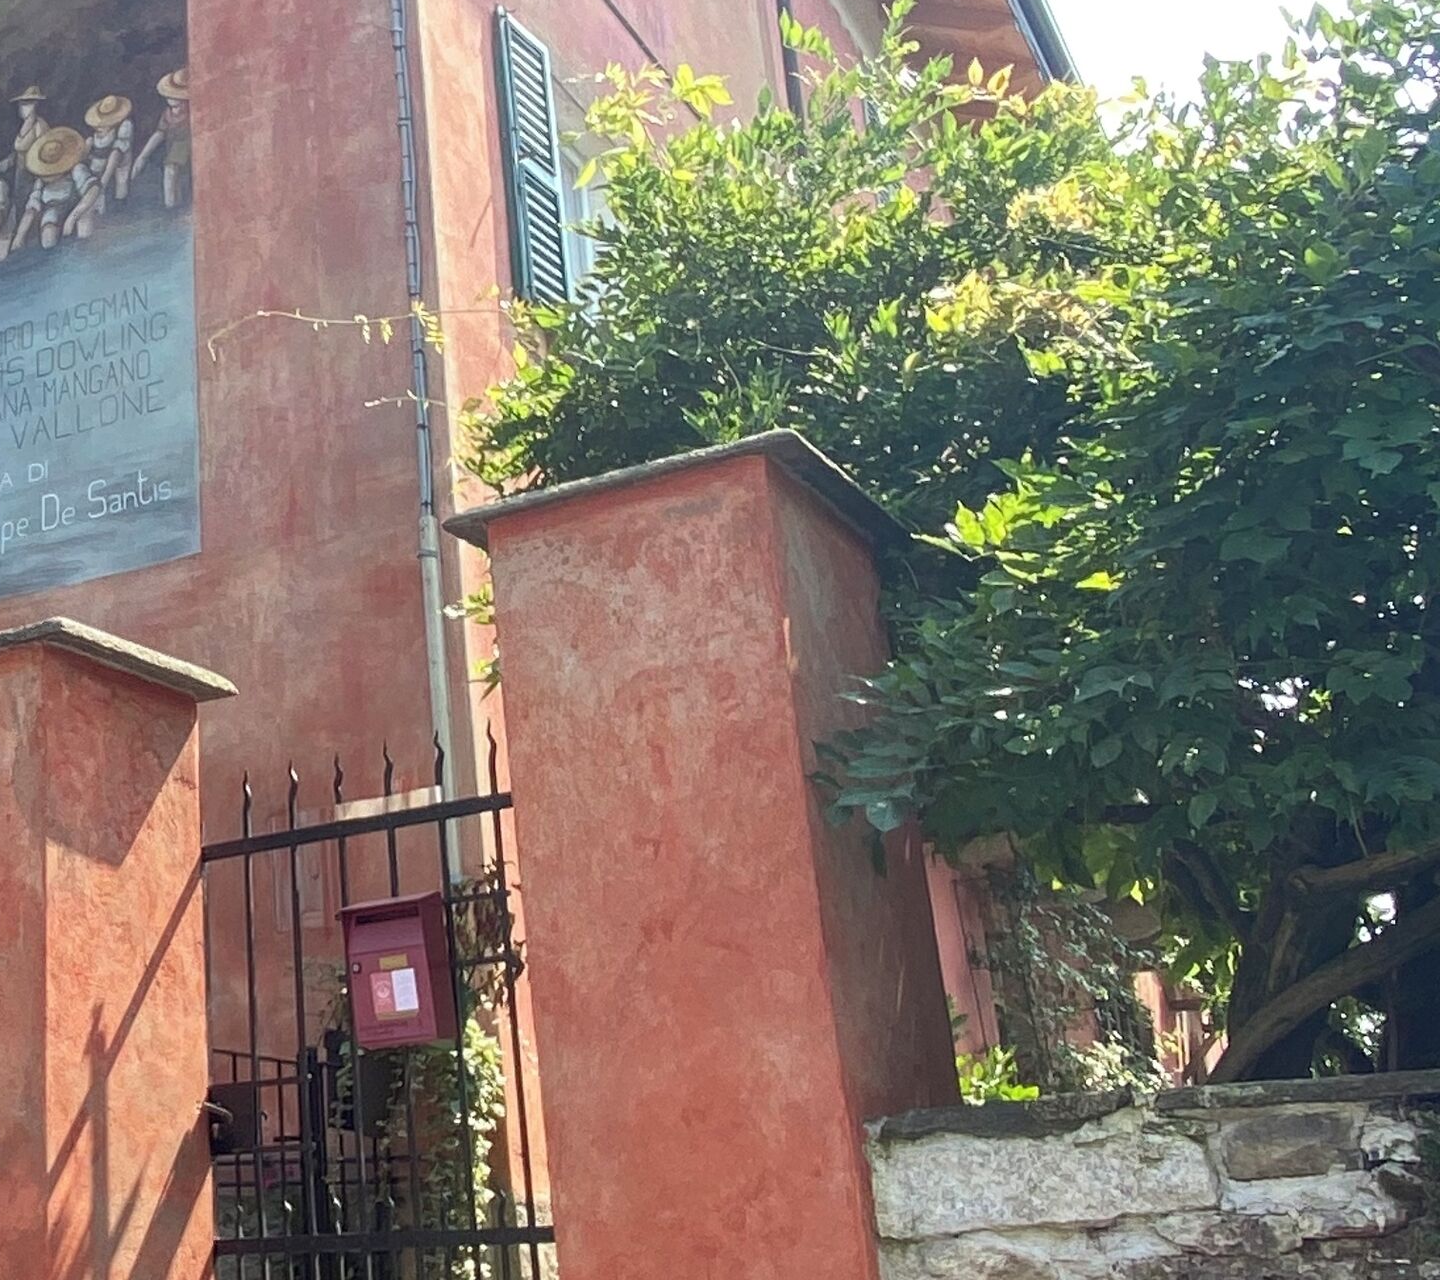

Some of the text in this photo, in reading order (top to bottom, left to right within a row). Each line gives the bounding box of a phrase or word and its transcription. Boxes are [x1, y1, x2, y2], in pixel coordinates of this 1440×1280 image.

[46, 282, 148, 343] GASSMAN
[35, 311, 168, 378] DOWLING
[42, 348, 152, 408] MANGANO
[11, 379, 166, 450] VALLONE
[27, 460, 50, 484] DI
[40, 492, 77, 532] De
[86, 470, 173, 520] Santis
